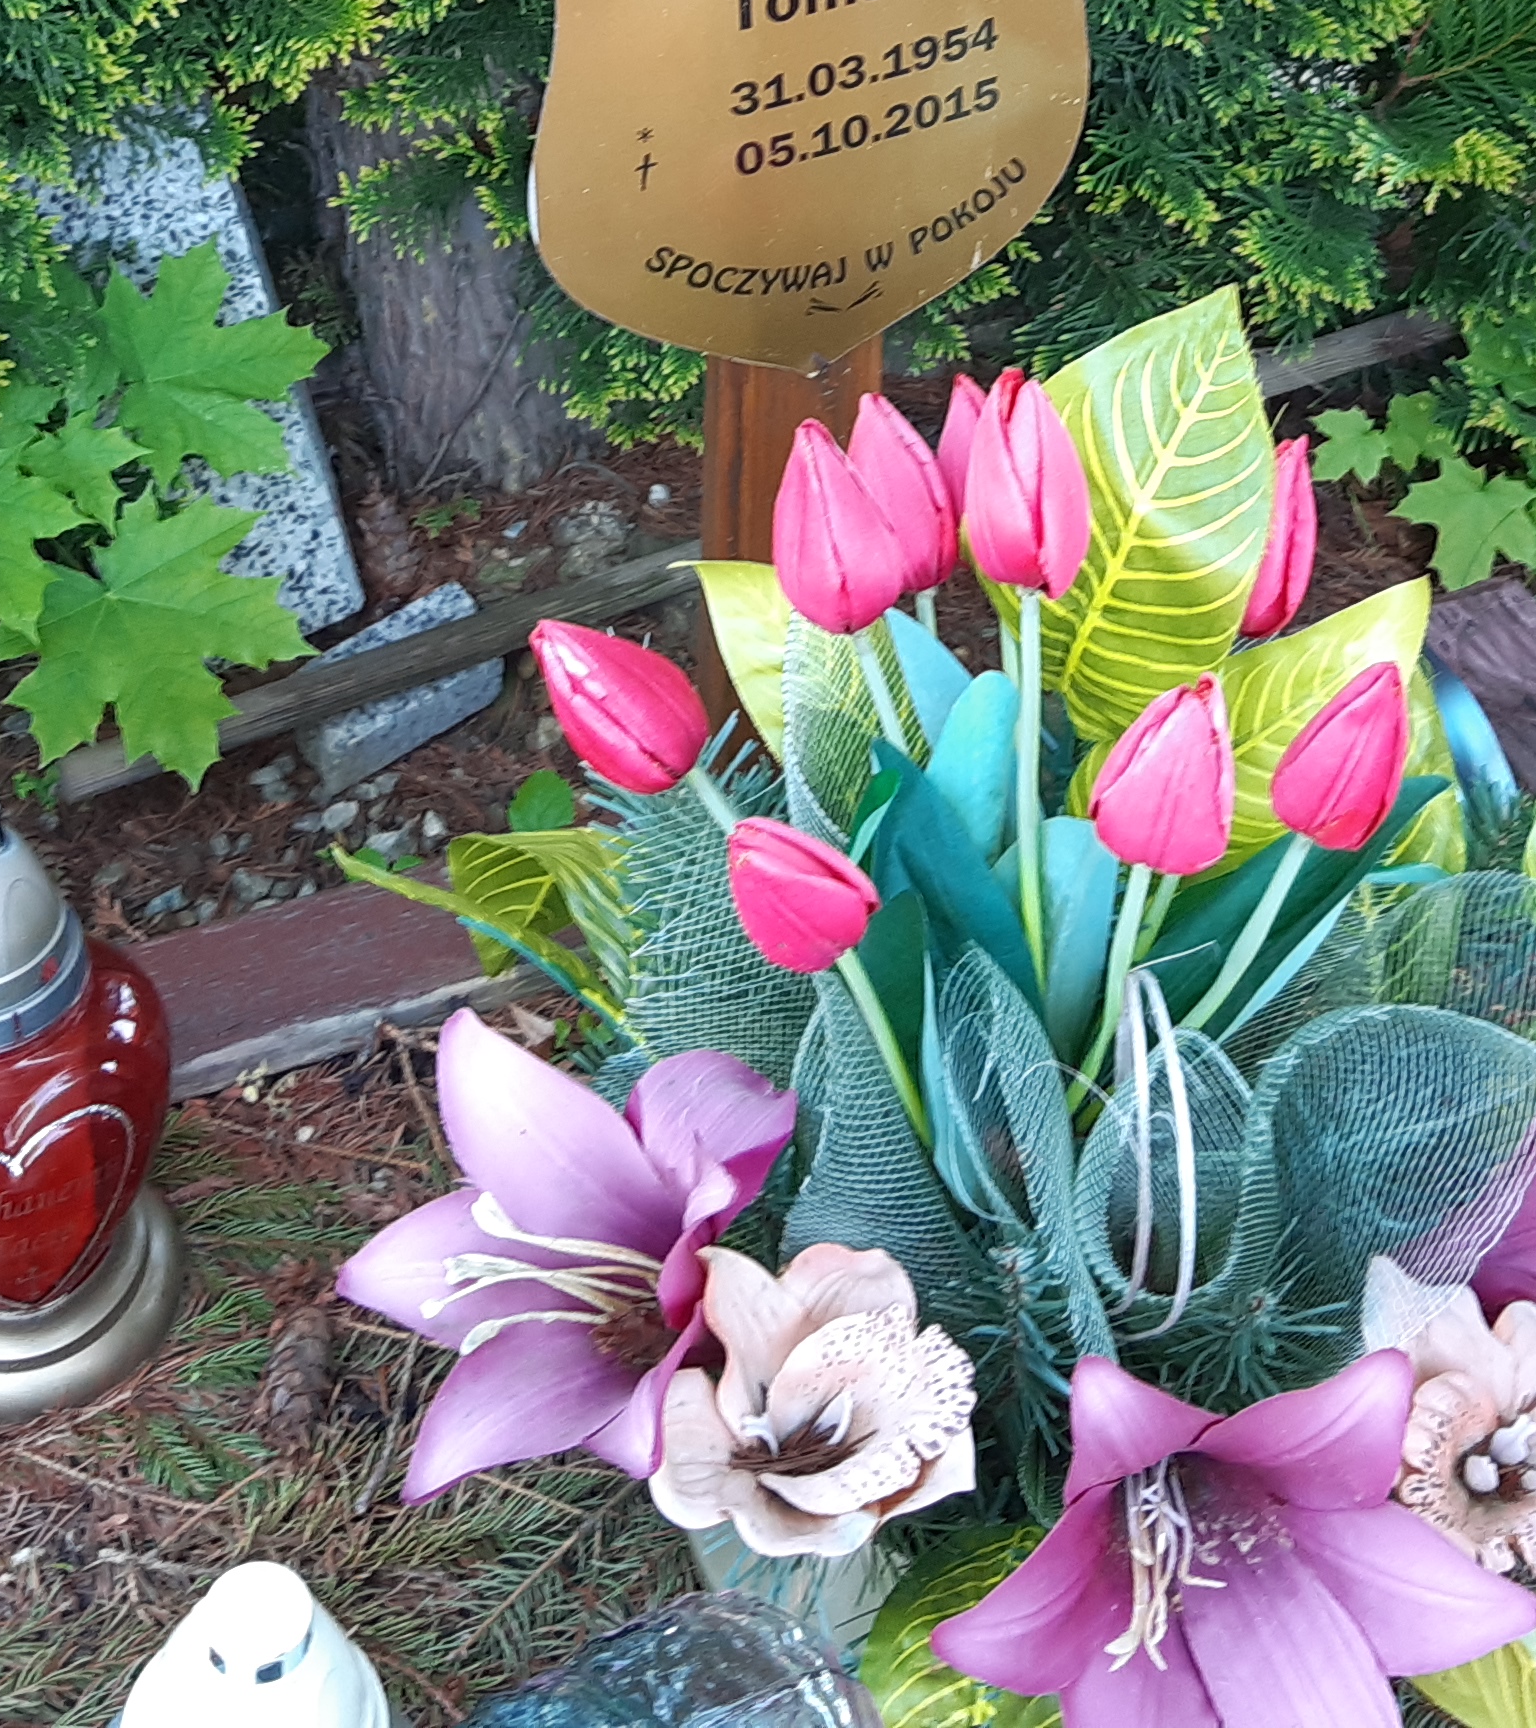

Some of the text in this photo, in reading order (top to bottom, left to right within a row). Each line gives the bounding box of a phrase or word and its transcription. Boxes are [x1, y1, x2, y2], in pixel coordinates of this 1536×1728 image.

[729, 16, 1000, 117] 31.03.1954
[734, 75, 1002, 175] 05.10.2015
[644, 156, 1028, 297] SPOCZYWAJ W POKOJU
